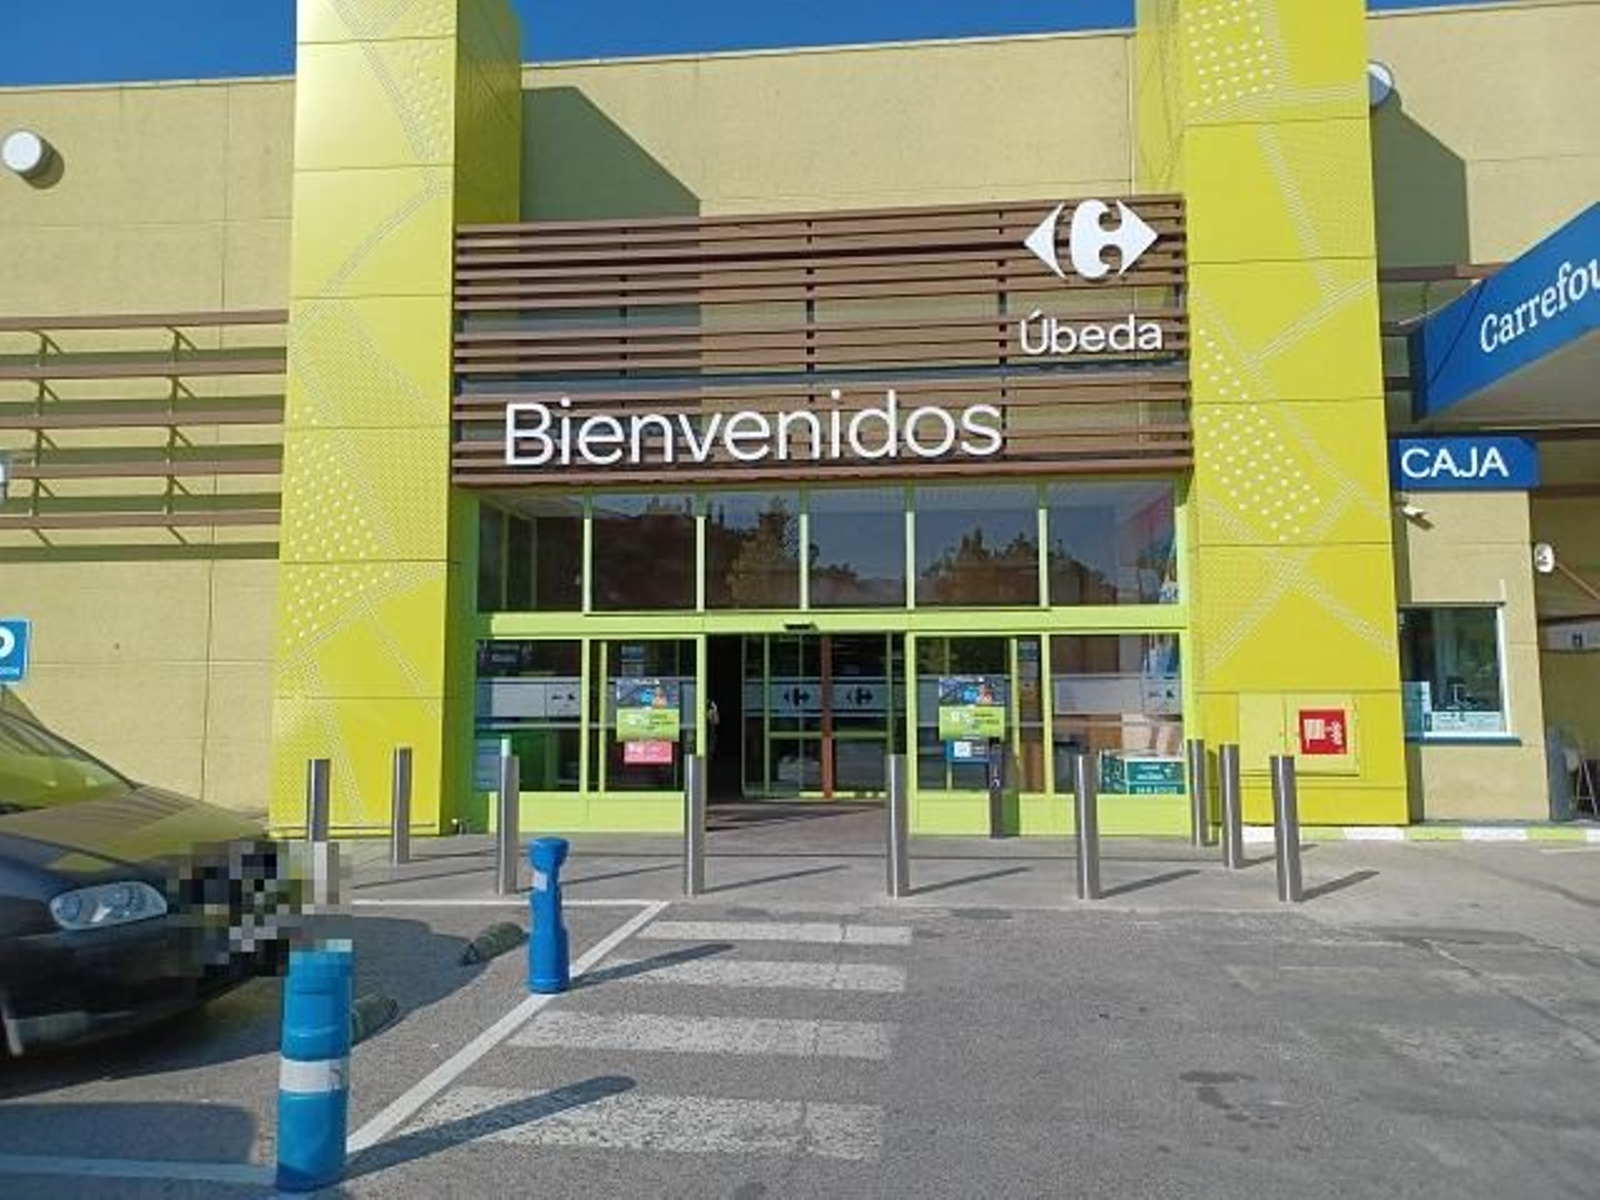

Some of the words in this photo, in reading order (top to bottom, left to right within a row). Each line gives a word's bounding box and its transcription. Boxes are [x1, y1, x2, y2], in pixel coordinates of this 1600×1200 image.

[1020, 309, 1164, 356] Úbeda
[503, 388, 1004, 467] Bienvenidos
[1401, 446, 1510, 478] CAJA
